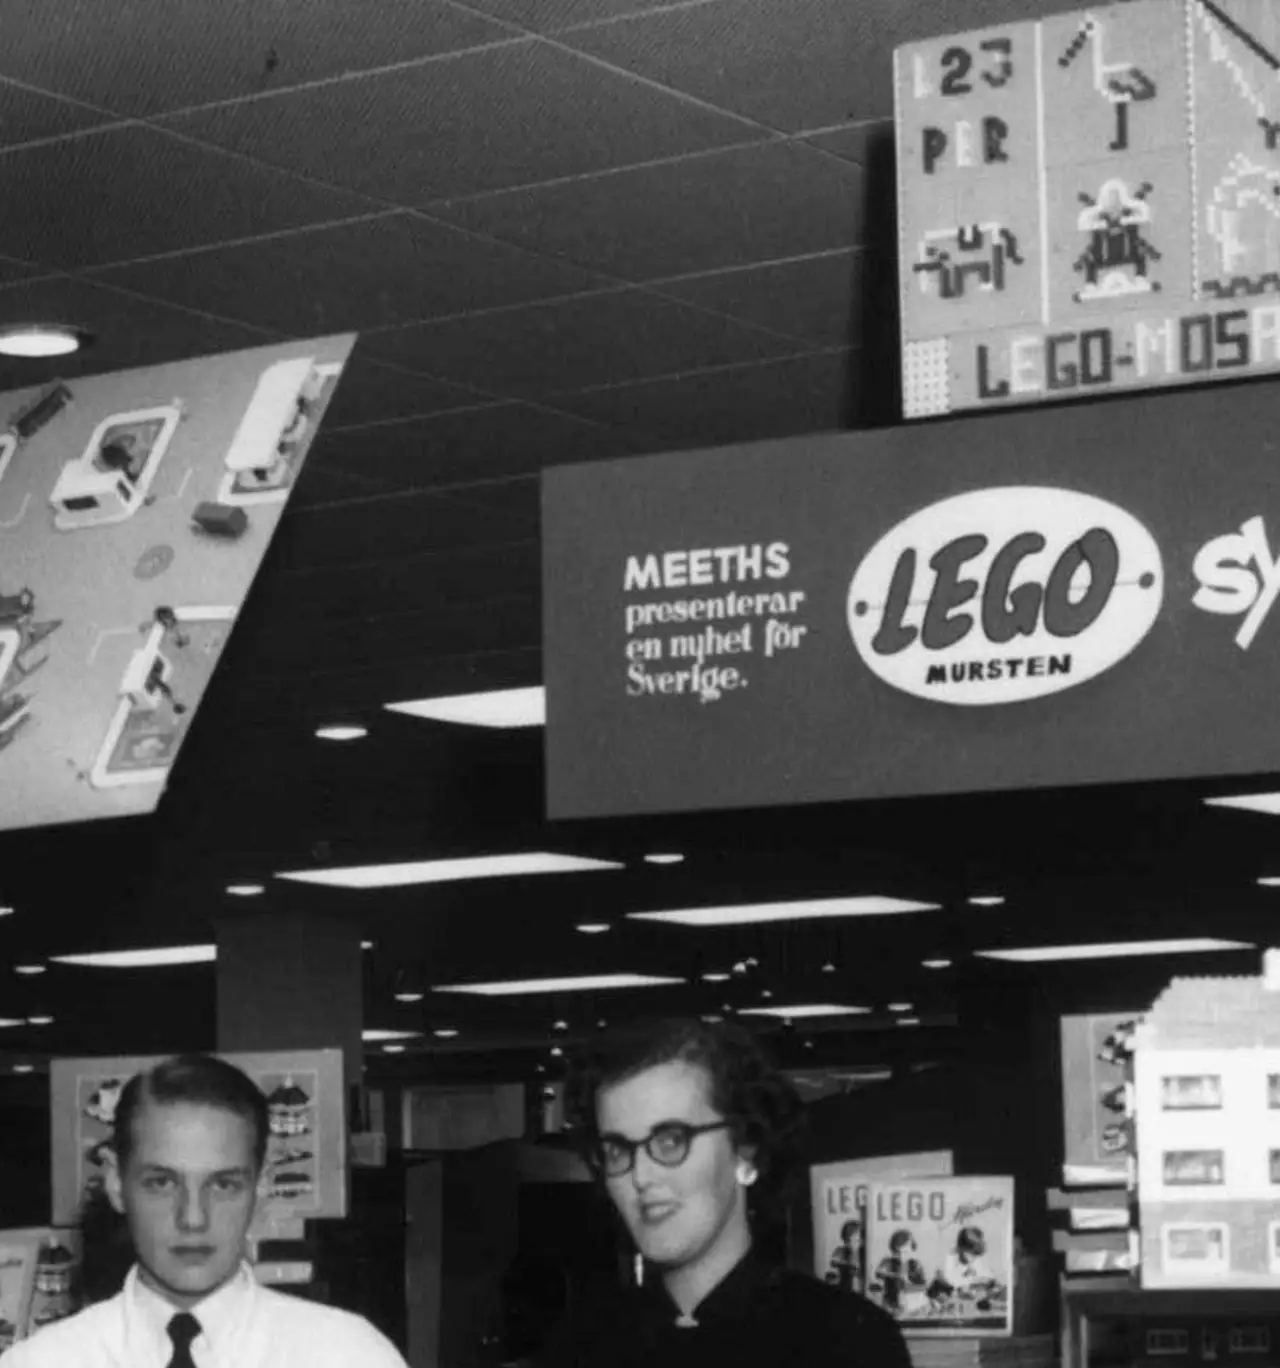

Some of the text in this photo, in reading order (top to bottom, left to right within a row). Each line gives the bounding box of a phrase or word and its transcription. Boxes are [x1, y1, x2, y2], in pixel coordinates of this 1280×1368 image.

[624, 542, 791, 592] MEETHS
[624, 590, 807, 636] presenterar
[871, 526, 1120, 656] LEGO
[625, 617, 808, 666] en nyhet för
[925, 653, 1073, 685] MURSTEN
[876, 1191, 946, 1222] LEGO
